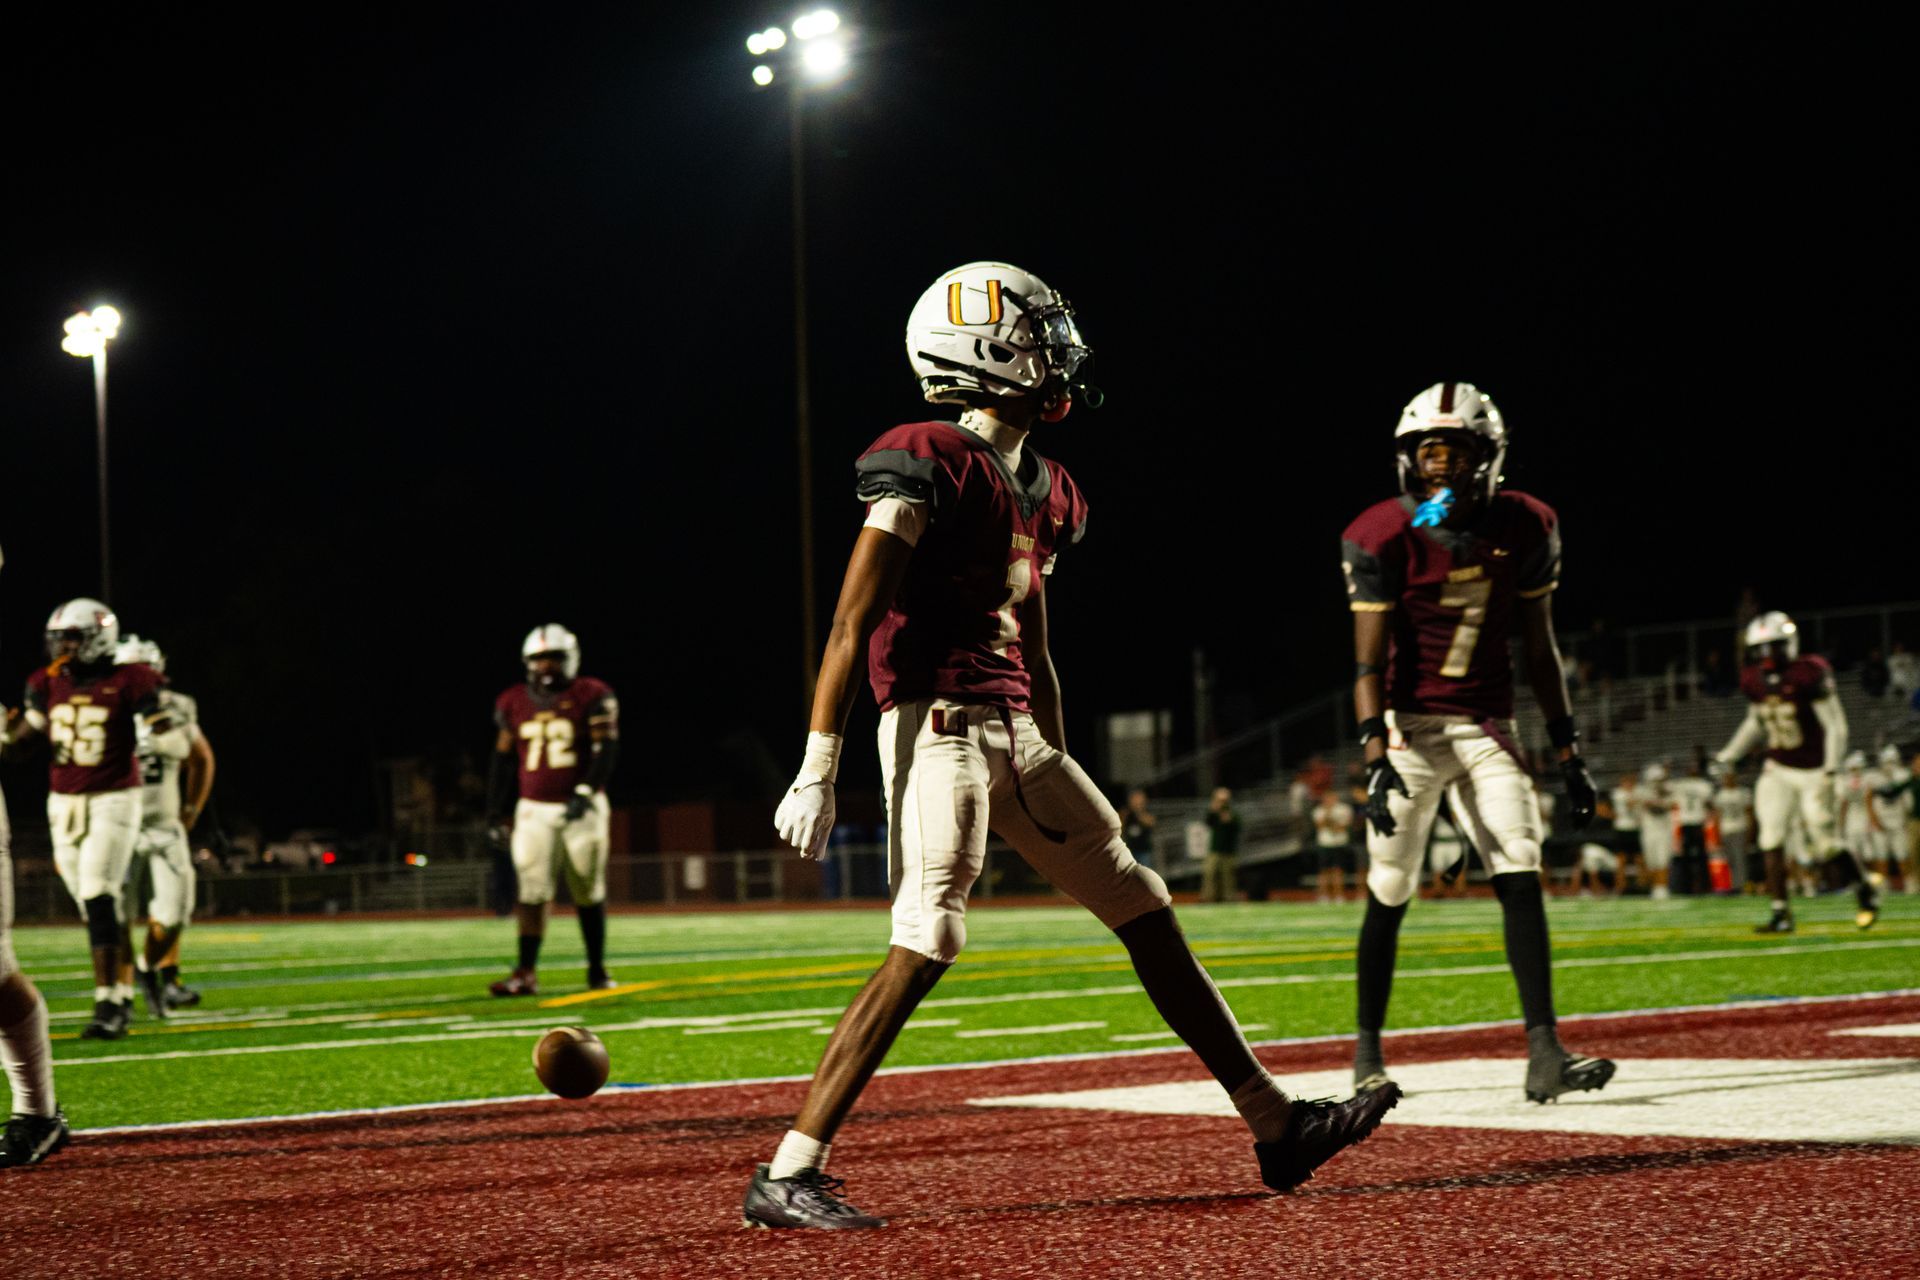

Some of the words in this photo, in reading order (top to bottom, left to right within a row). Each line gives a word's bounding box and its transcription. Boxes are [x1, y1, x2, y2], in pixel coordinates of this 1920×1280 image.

[948, 279, 1004, 326] U
[1439, 579, 1493, 677] 7
[519, 718, 577, 772] 72
